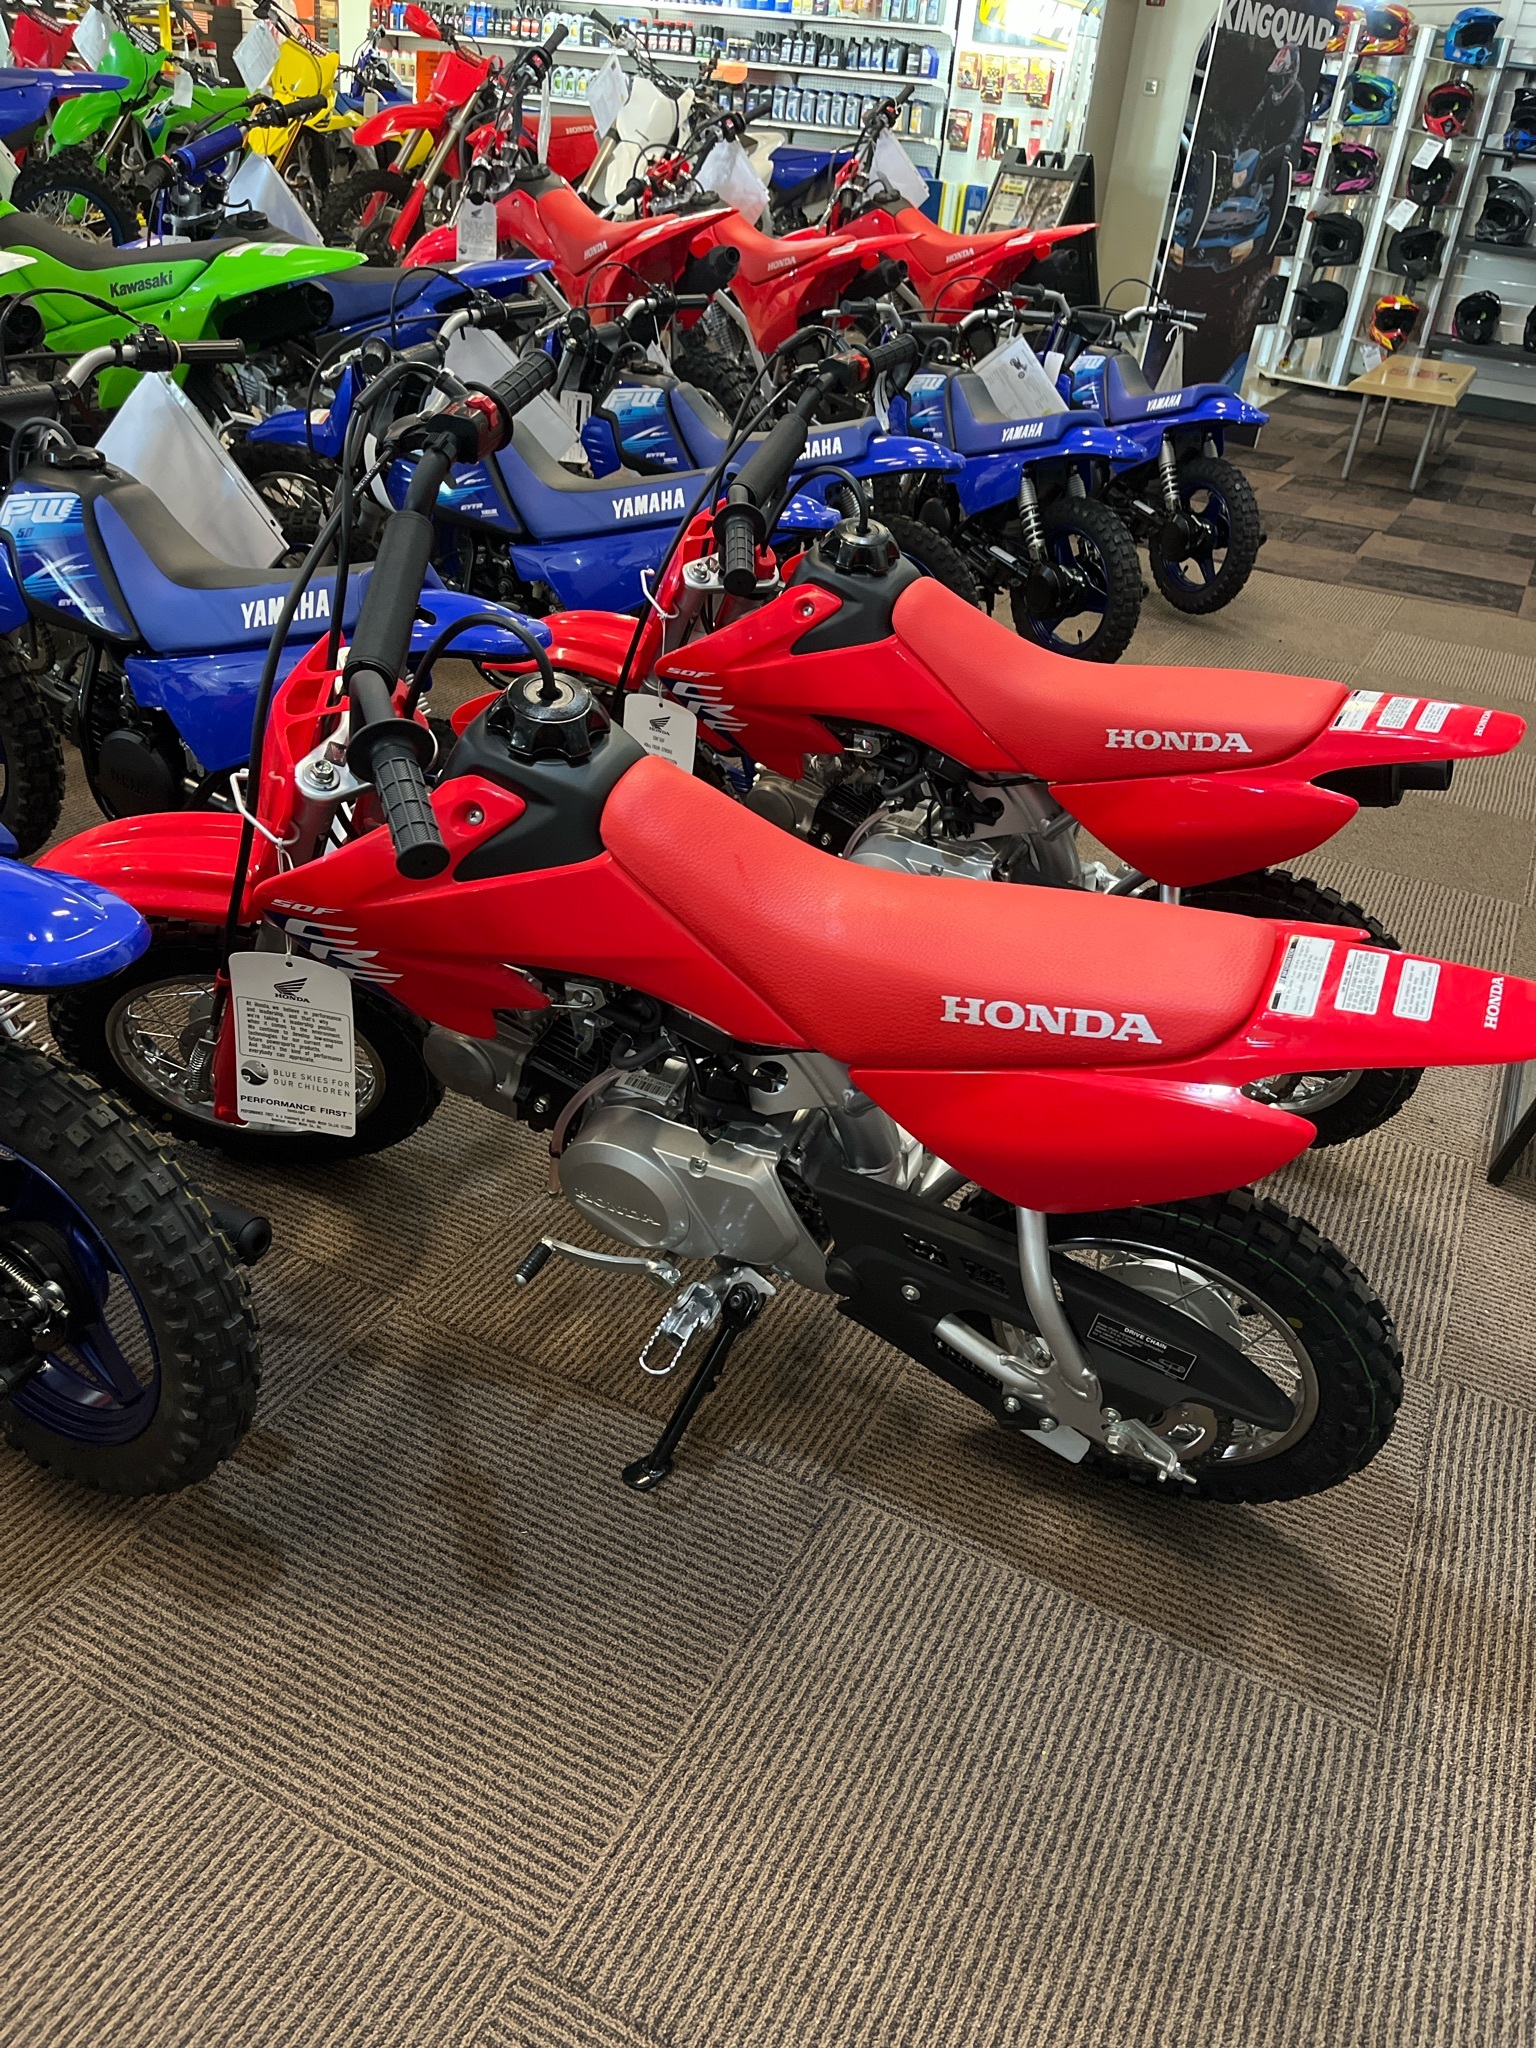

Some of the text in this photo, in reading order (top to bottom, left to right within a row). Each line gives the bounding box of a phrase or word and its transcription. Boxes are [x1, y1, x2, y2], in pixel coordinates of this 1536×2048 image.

[1219, 0, 1332, 51] KINGQUAD
[566, 124, 596, 135] HONDA
[584, 240, 608, 260] HONDA
[946, 248, 975, 264] HONDA
[768, 256, 796, 272] HONDA
[110, 270, 172, 298] Kawasaki
[606, 391, 662, 408] PW
[1146, 393, 1182, 412] YAMAHA
[1002, 422, 1044, 442] YAMAHA
[797, 436, 842, 461] MAHA
[0, 498, 77, 527] PW
[460, 502, 484, 511] GYTR
[612, 488, 686, 520] YAMAHA
[16, 527, 34, 538] 50
[672, 682, 749, 732] CRF
[648, 726, 670, 736] HONDA
[1474, 710, 1493, 737] HONDA
[1104, 728, 1252, 752] HONDA
[270, 898, 344, 915] 50F
[284, 918, 404, 984] CRF
[275, 992, 310, 1003] HONDA
[1484, 976, 1504, 1030] HONDA
[290, 1020, 314, 1028] leadership
[312, 1012, 341, 1021] performance
[940, 995, 1162, 1044] HONDA
[248, 1030, 277, 1039] technologies
[314, 1035, 343, 1045] low-emission
[249, 1048, 272, 1056] everybody
[267, 1039, 295, 1048] powersports
[314, 1053, 342, 1062] performance
[274, 1069, 297, 1079] BLUE
[301, 1074, 328, 1084] SKIES
[274, 1078, 350, 1097] OUR CHILDREN
[240, 1095, 316, 1112] PERFORMANCE
[1124, 1327, 1145, 1340] DRIVE
[1145, 1336, 1167, 1350] CHAIN
